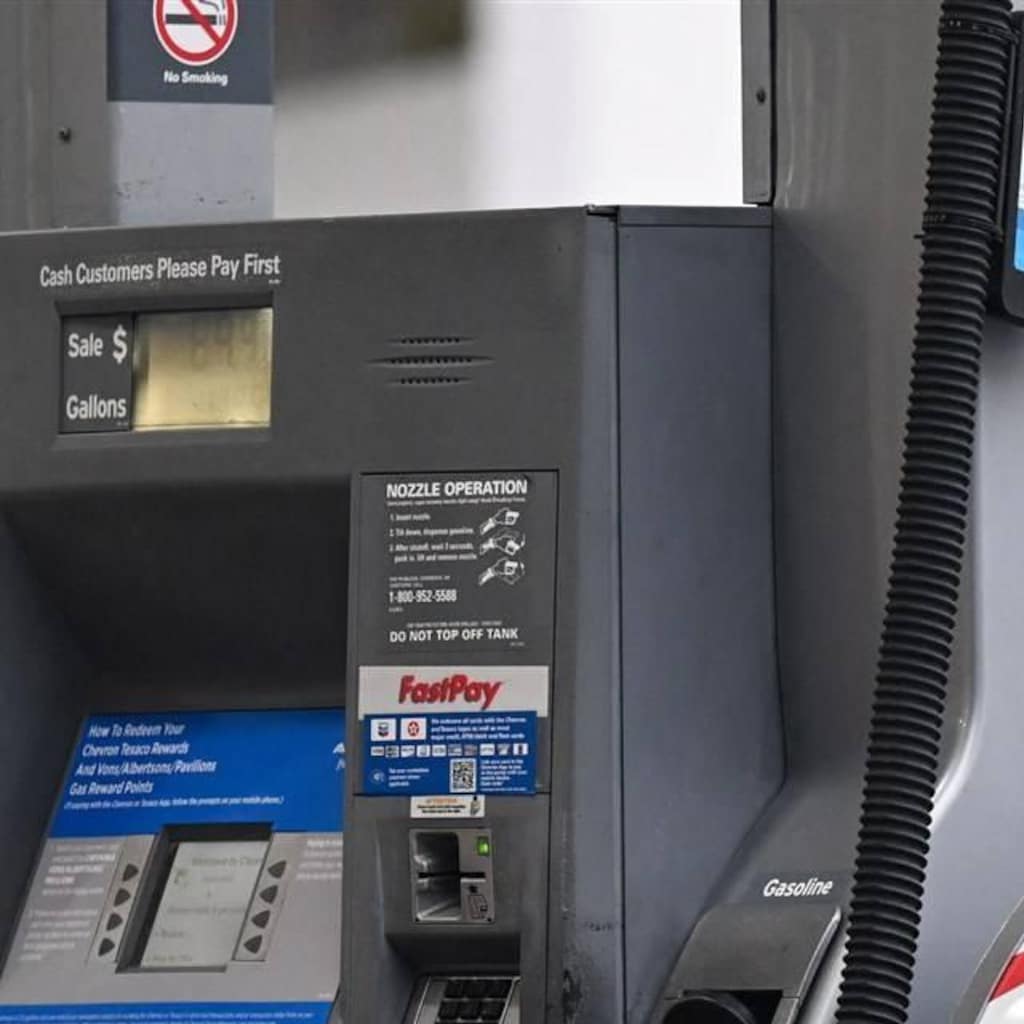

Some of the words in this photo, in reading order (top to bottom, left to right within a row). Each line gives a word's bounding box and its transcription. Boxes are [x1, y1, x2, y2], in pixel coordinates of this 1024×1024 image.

[163, 70, 180, 84] No
[181, 70, 229, 87] Smoking
[39, 265, 73, 288] Cash
[76, 262, 153, 285] Customers
[157, 257, 207, 279] Please
[211, 255, 240, 281] Pay
[244, 253, 281, 276] First
[68, 333, 103, 358] Sale
[112, 325, 128, 364] $
[66, 395, 127, 420] Gallons
[386, 483, 441, 498] NOZZLE
[444, 480, 527, 496] OPERATION
[389, 631, 407, 643] DO
[409, 630, 433, 642] NOT
[436, 629, 460, 641] TOP
[461, 629, 484, 641] OFF
[486, 628, 519, 639] TANK
[398, 674, 504, 711] FastPay
[89, 724, 110, 737] How
[112, 724, 123, 736] To
[123, 723, 163, 736] Redeem
[164, 723, 186, 735] Your
[82, 744, 120, 757] Chevron
[121, 743, 150, 756] Texaco
[151, 741, 190, 755] Rewards
[75, 763, 95, 776] And
[69, 783, 87, 796] Gas
[88, 781, 124, 795] Reward
[124, 781, 154, 794] Points
[763, 877, 833, 897] Gasoline
